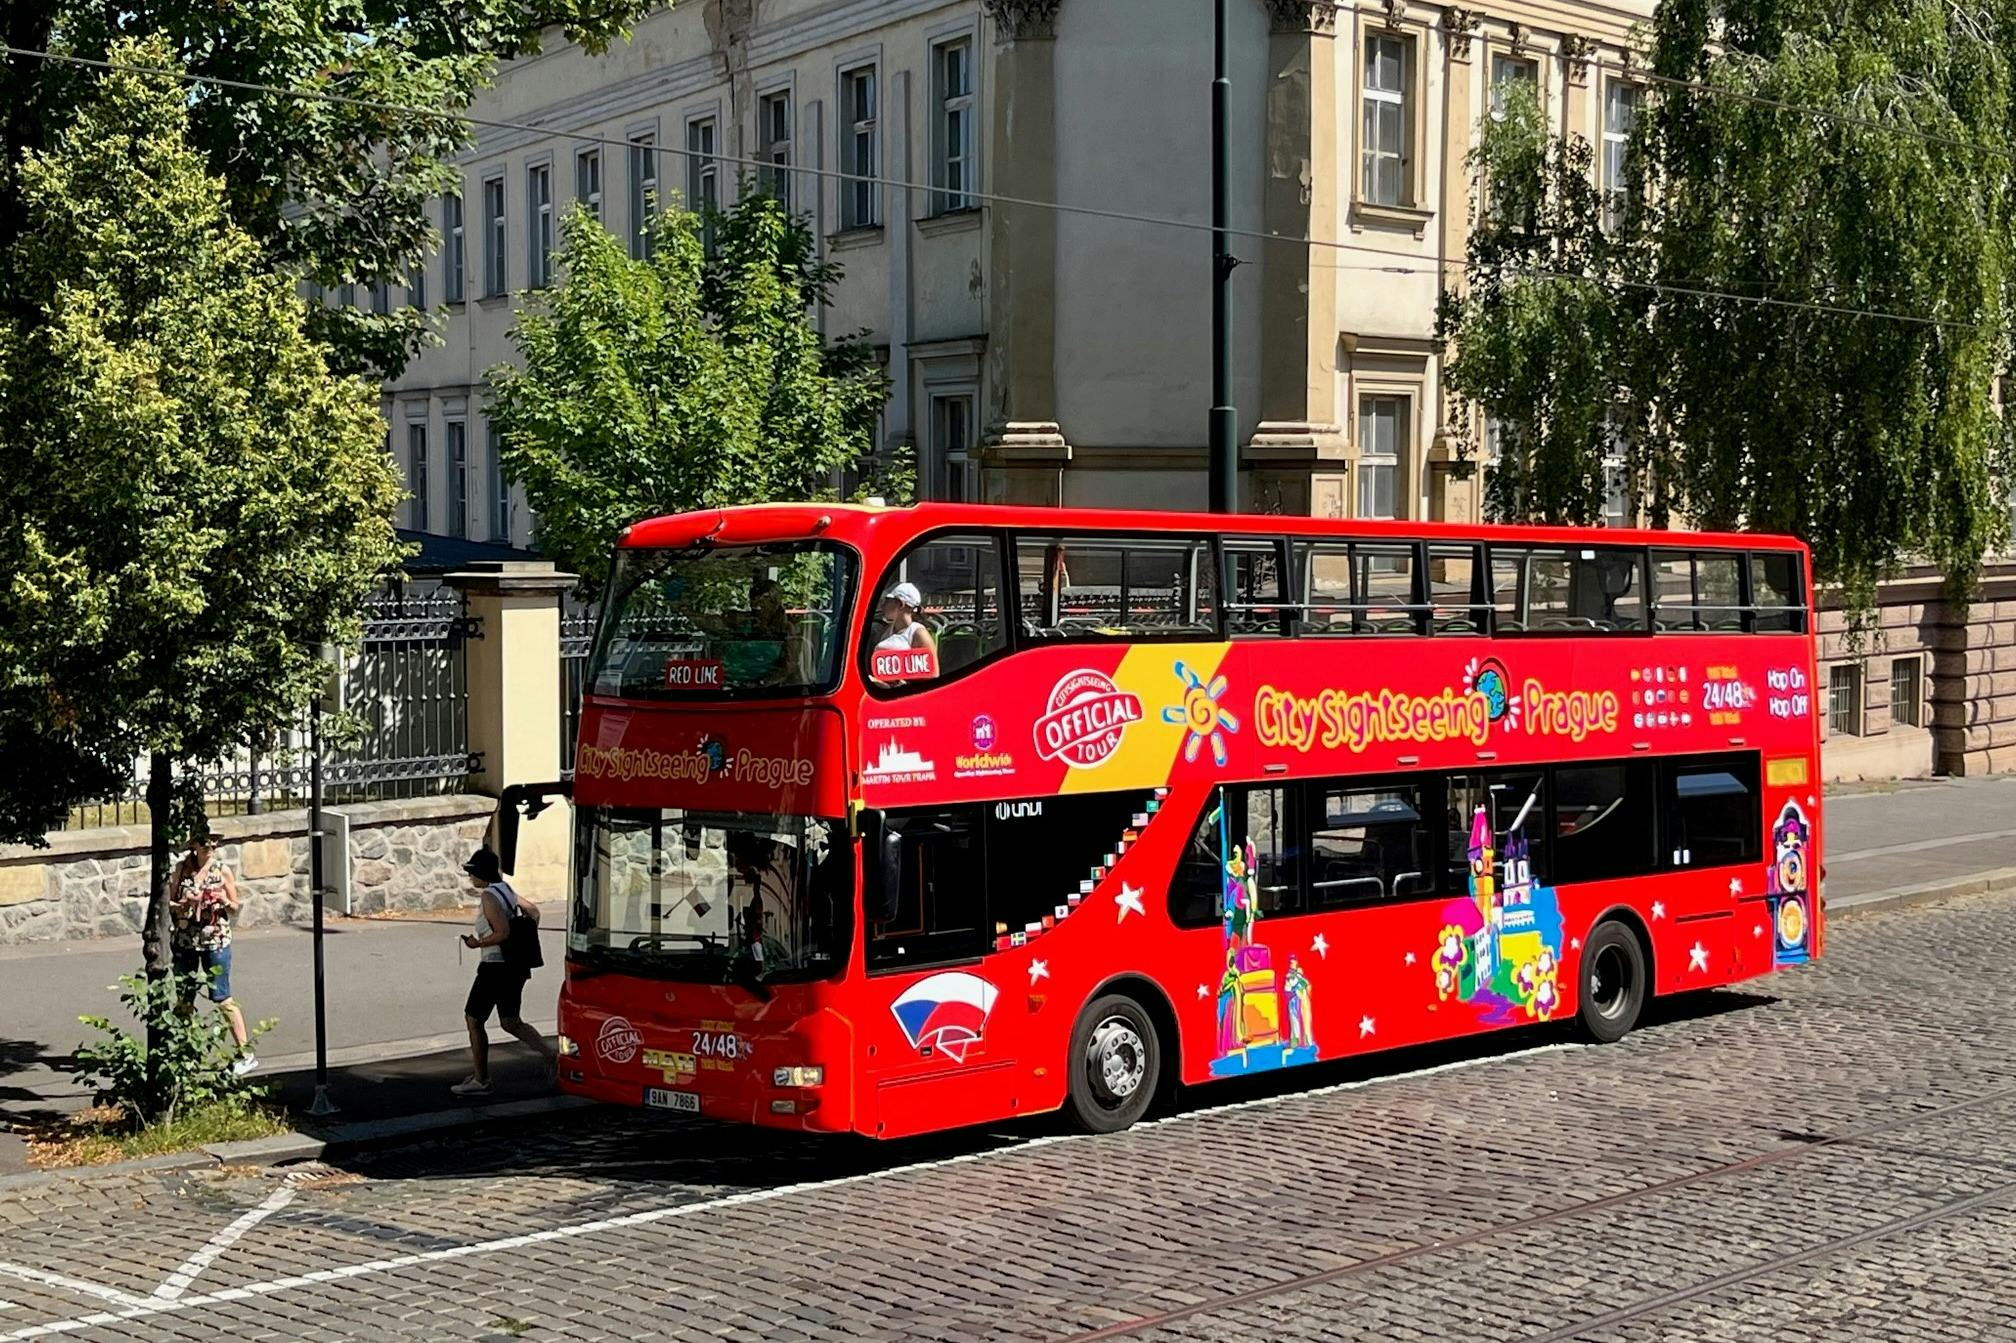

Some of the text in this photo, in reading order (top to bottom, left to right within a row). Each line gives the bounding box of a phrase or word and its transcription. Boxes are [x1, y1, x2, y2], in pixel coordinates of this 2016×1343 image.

[669, 666, 719, 684] RED LINE
[877, 654, 930, 676] RED LINE
[1767, 667, 1804, 691] Hop On
[1703, 681, 1742, 710] 24/48
[1769, 695, 1808, 719] Hop Off
[1523, 678, 1618, 743] Prague
[867, 718, 911, 729] OPERATED
[1045, 697, 1138, 749] OFFICIAL
[1077, 732, 1119, 761] TOUR
[736, 747, 814, 789] Prague
[601, 1032, 641, 1053] OFFICIAL
[692, 1031, 737, 1058] 24/48
[642, 1050, 696, 1073] MAN
[651, 1091, 696, 1109] 9AN 7866
